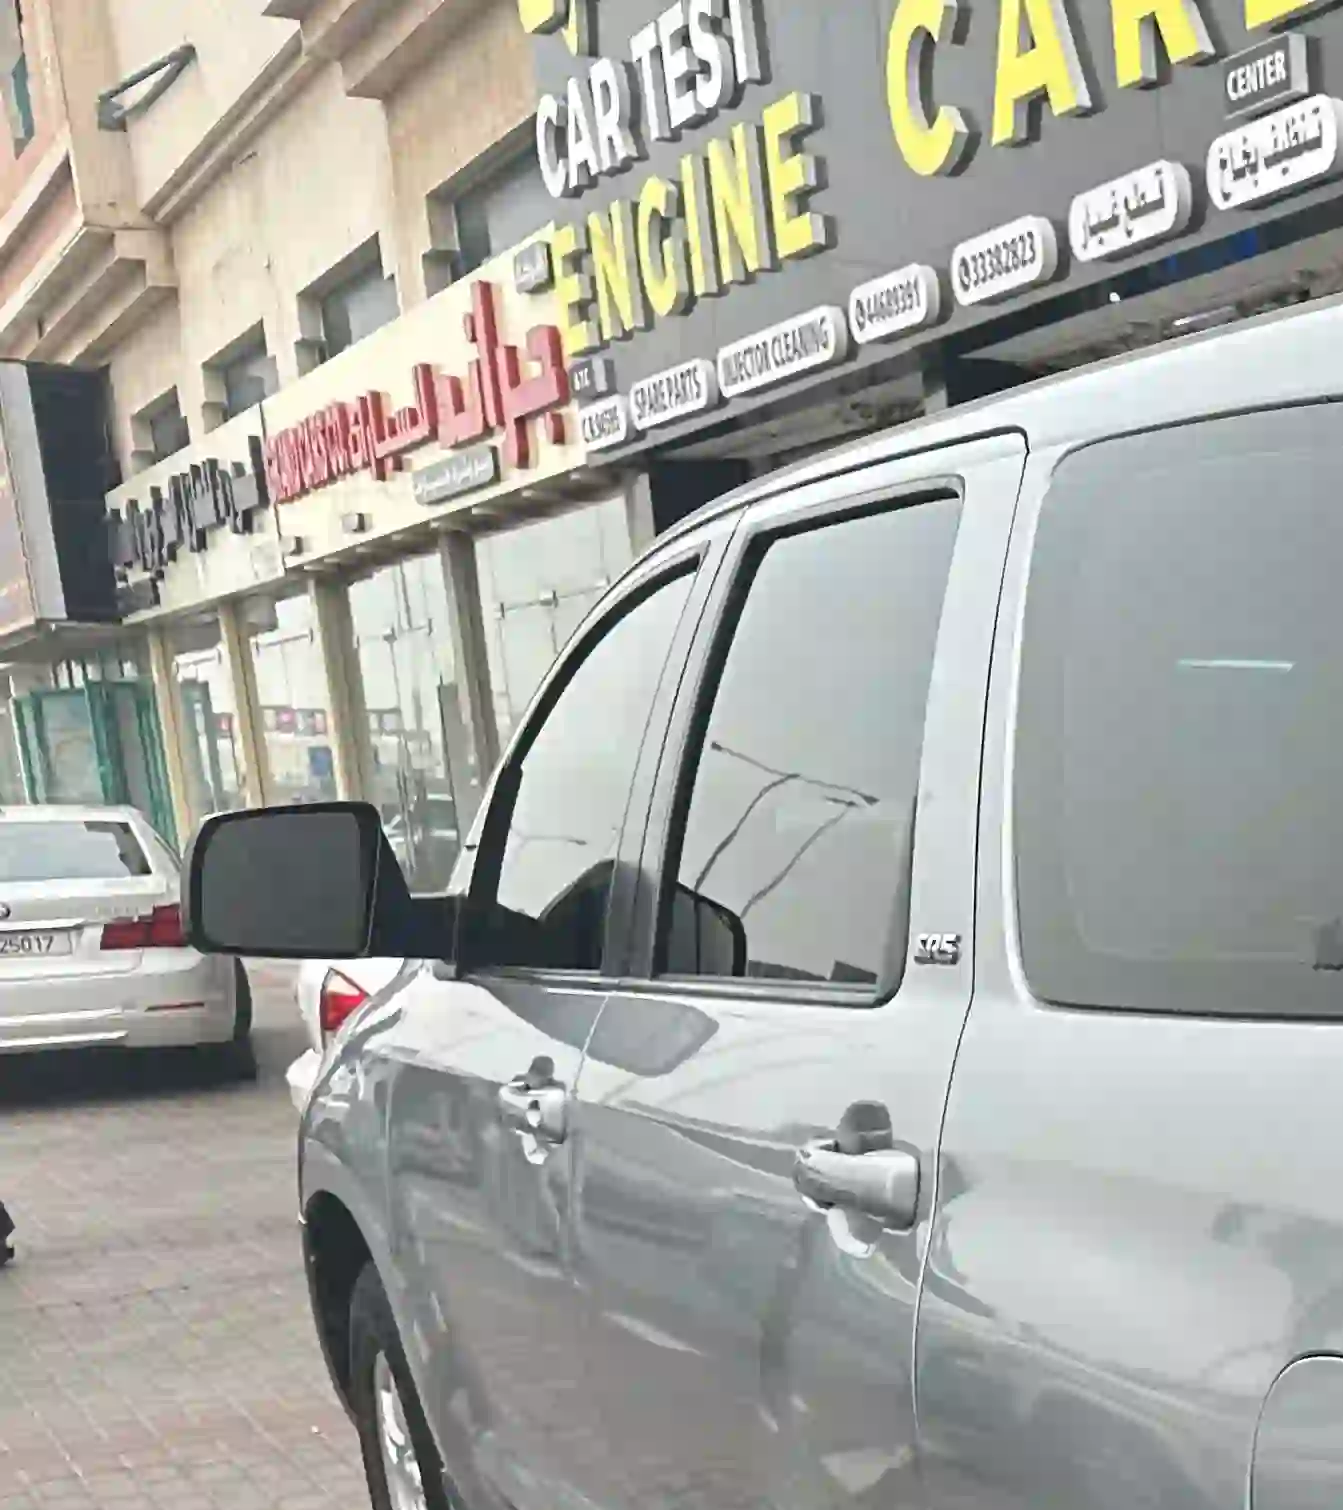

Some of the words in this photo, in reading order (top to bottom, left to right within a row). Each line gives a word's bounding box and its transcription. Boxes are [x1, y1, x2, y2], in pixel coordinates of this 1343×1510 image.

[1226, 50, 1288, 101] CENTER
[536, 57, 640, 198] CAR
[550, 91, 830, 356] ENGINE
[722, 338, 770, 388] INJECTOR
[770, 315, 830, 372] CLEANING
[634, 376, 667, 422] SPARE
[667, 366, 701, 410] PARTS
